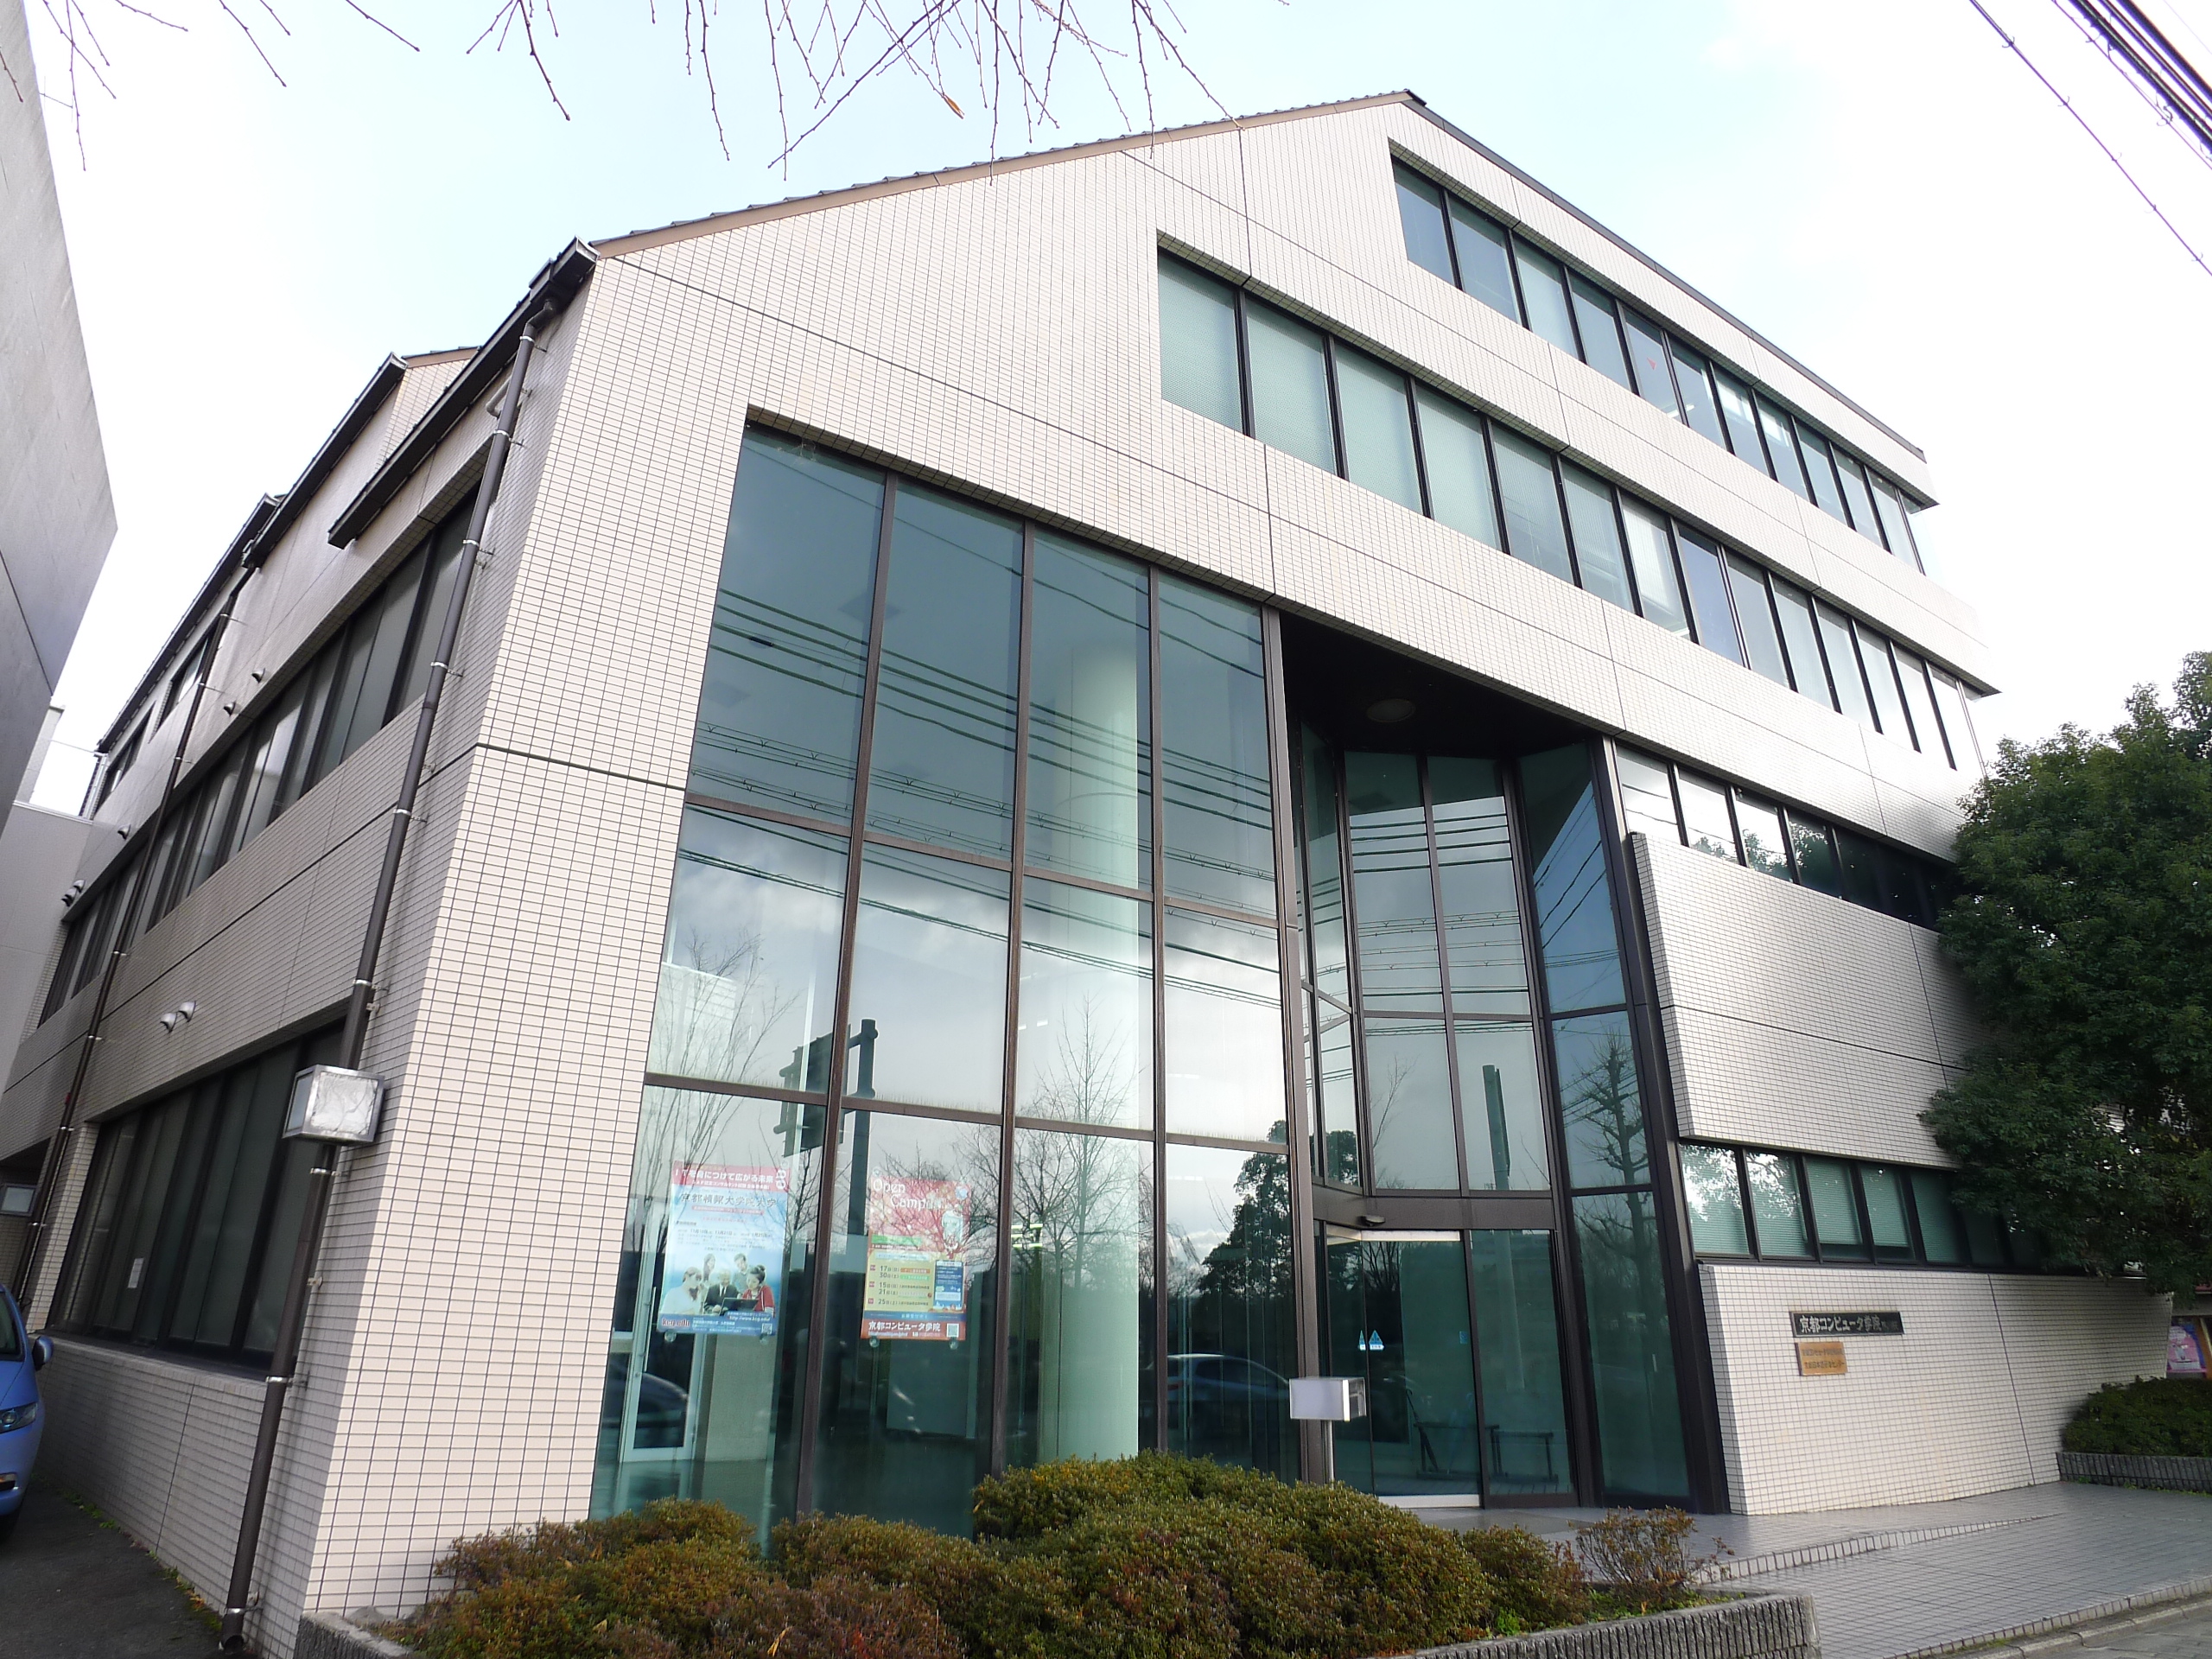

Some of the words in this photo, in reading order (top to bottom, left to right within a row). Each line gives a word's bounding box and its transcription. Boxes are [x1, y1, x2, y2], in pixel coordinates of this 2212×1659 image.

[873, 1178, 906, 1194] Open
[681, 1192, 778, 1208] 京都情報大学院大学
